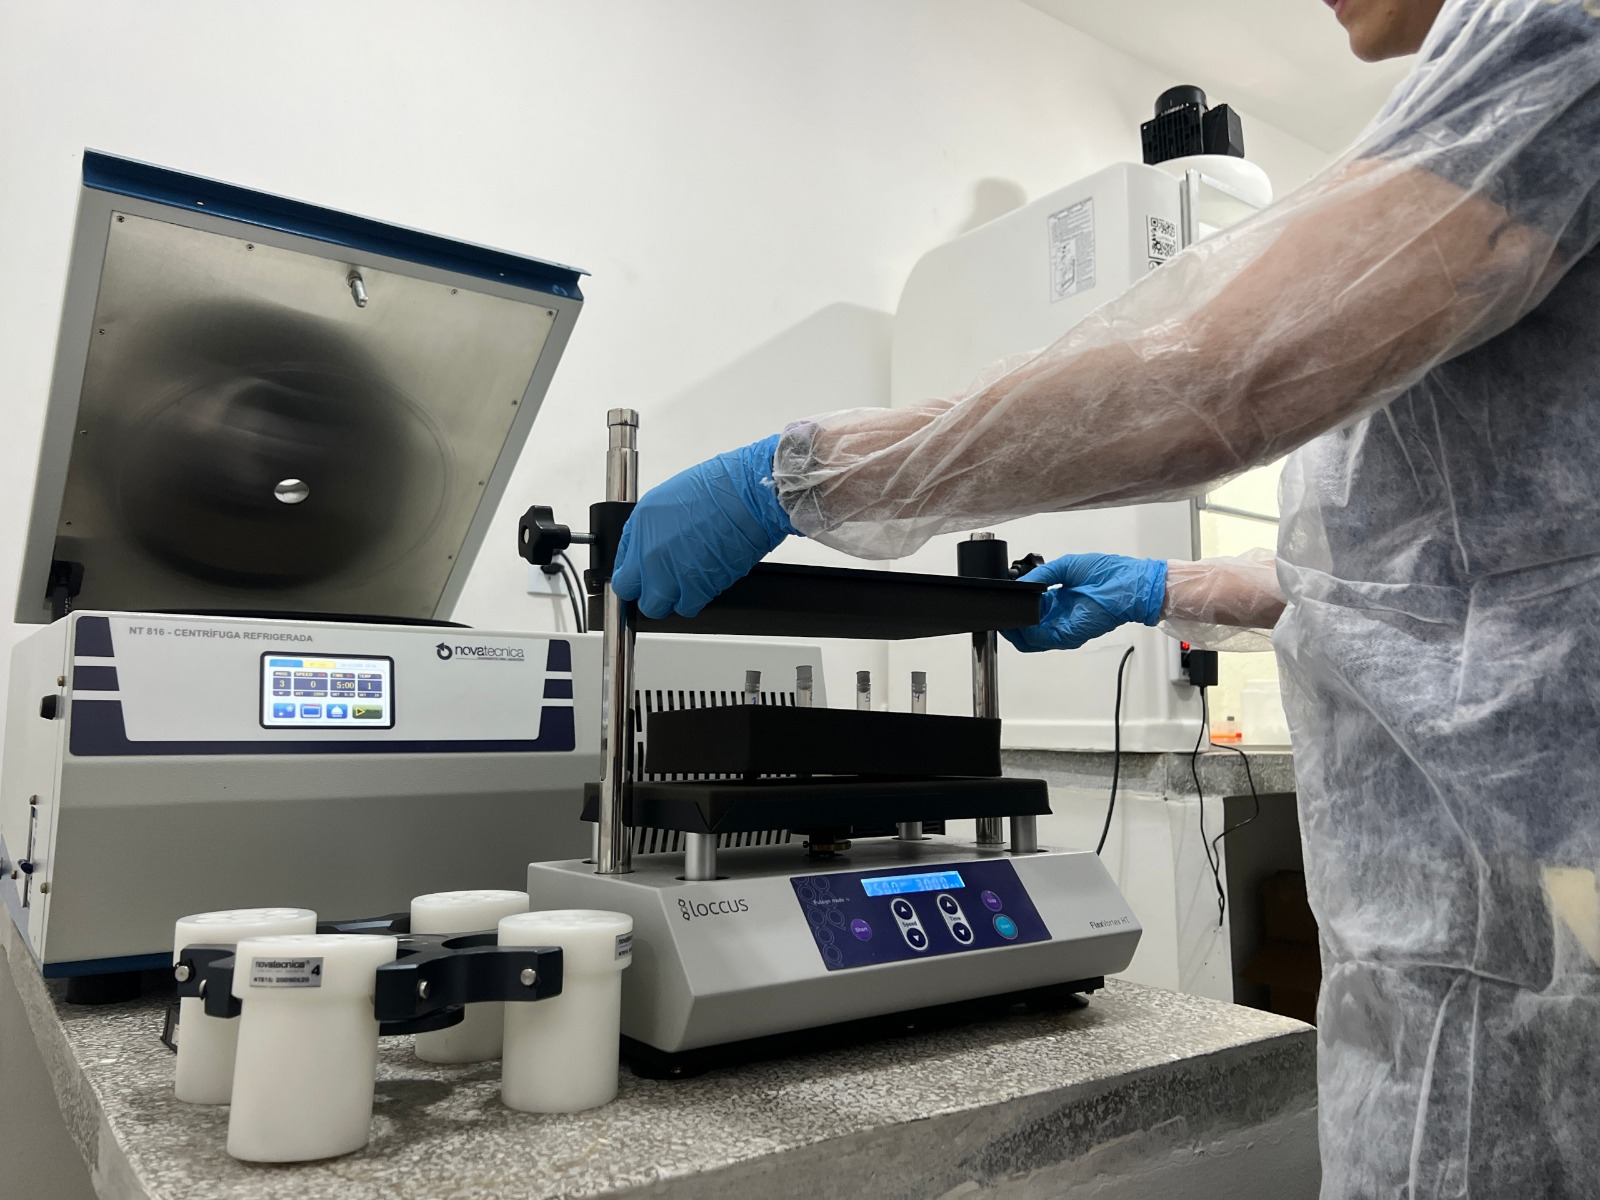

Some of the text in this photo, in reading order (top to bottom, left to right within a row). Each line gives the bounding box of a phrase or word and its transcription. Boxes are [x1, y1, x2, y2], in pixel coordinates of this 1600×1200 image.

[128, 626, 145, 636] NT
[146, 627, 165, 636] 816
[174, 627, 241, 640] CENTRÍFUGA
[243, 631, 314, 643] REFRIGERADA
[455, 645, 525, 658] novatecnica
[279, 679, 285, 688] 3
[310, 680, 317, 688] 0
[336, 681, 355, 690] 5:00
[367, 682, 372, 690] 1
[902, 920, 918, 928] Speed
[311, 964, 321, 976] 4
